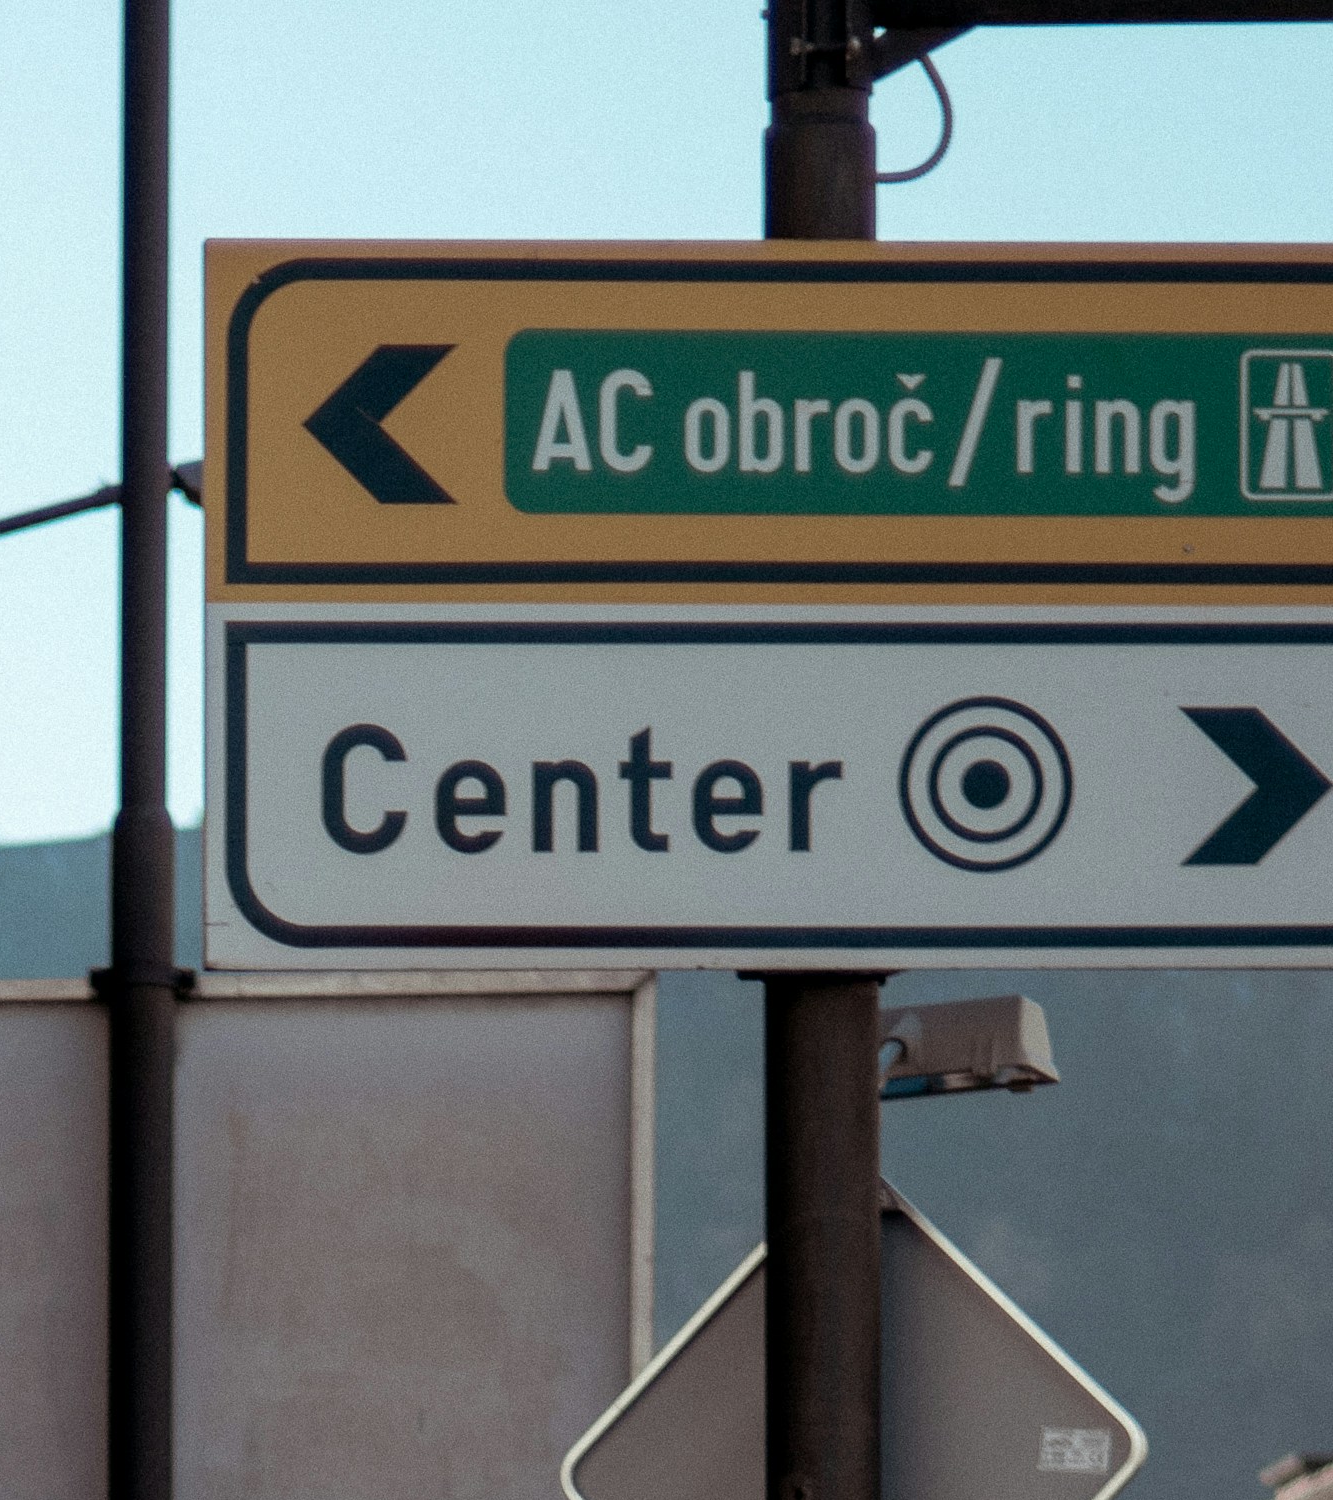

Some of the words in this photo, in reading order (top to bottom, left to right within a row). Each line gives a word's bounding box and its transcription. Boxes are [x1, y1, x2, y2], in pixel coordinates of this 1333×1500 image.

[533, 369, 653, 474] AC
[683, 357, 1195, 502] obroč/ring
[321, 724, 843, 853] Center
